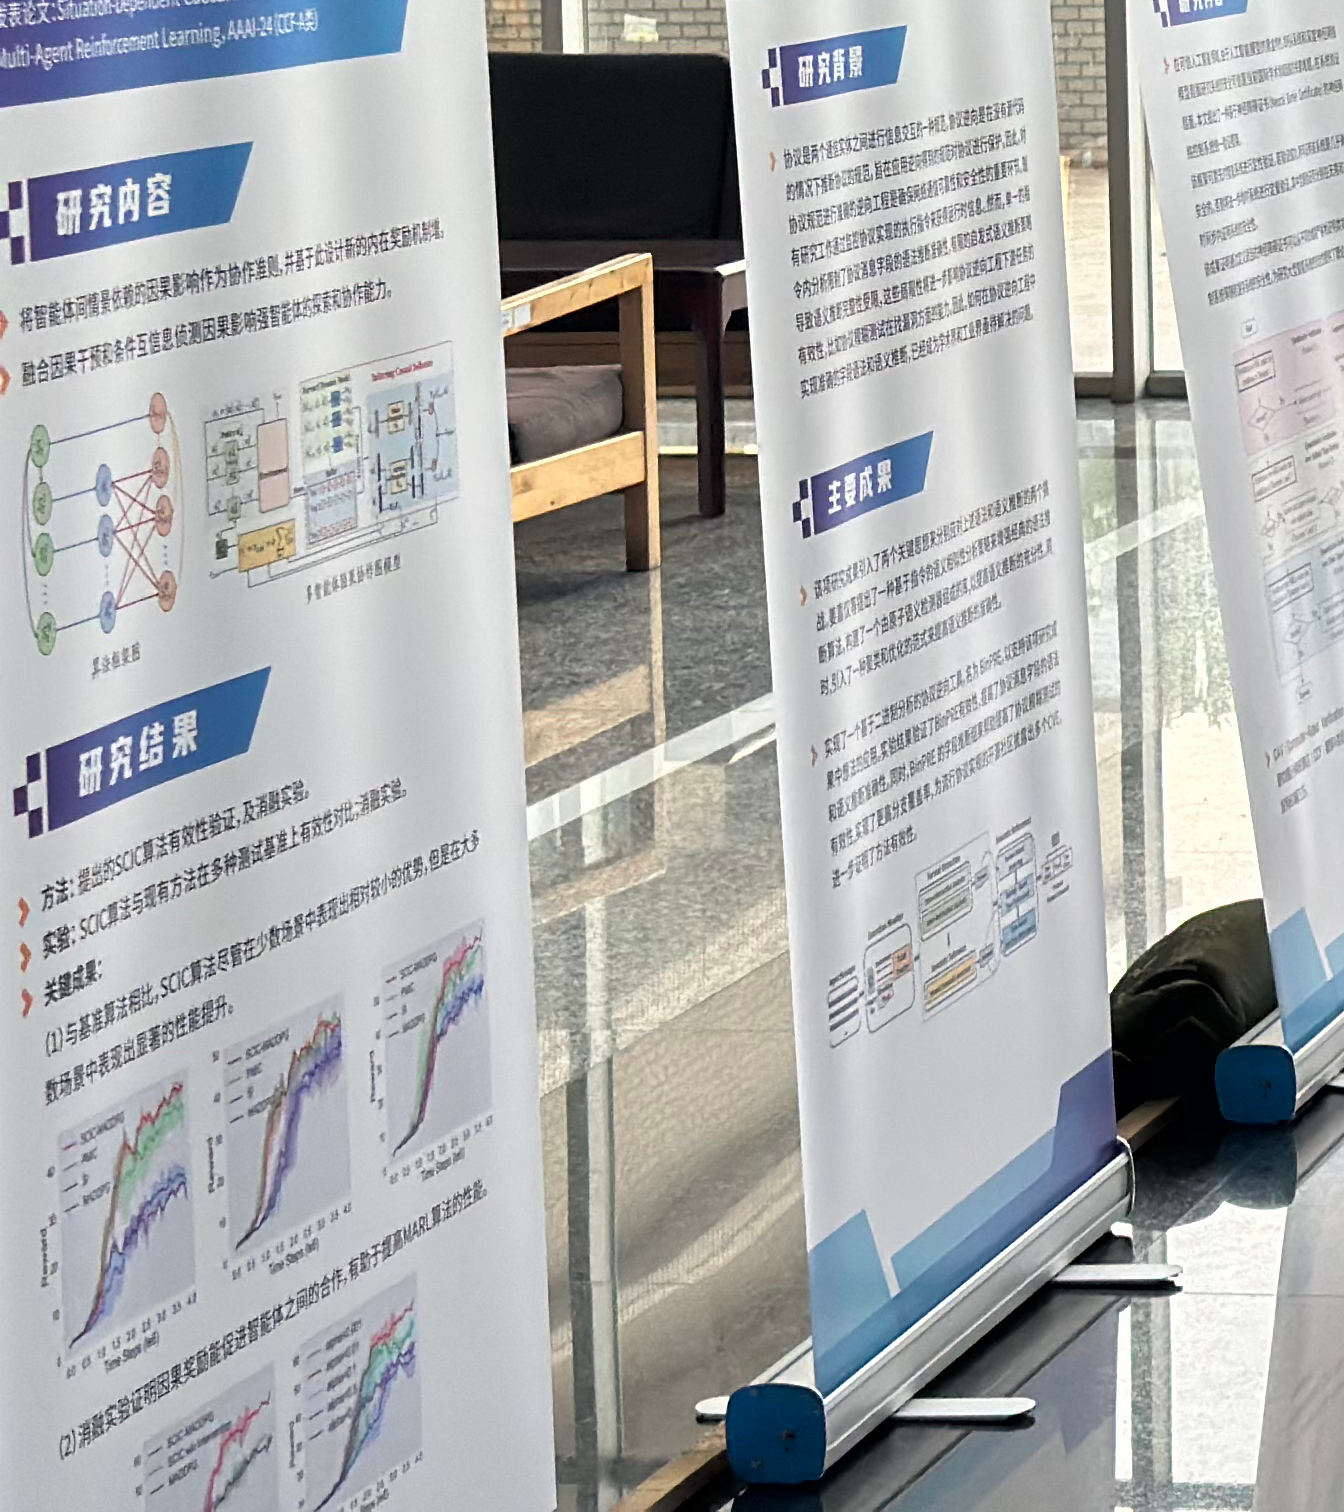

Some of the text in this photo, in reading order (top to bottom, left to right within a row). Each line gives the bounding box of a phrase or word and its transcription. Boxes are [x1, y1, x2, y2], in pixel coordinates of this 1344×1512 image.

[76, 29, 160, 65] Reinforcement
[161, 21, 226, 49] Learning,
[797, 44, 863, 90] 研究背景
[55, 172, 173, 236] 研究内容
[827, 458, 893, 516] 主要成果
[78, 709, 199, 798] 研究结果
